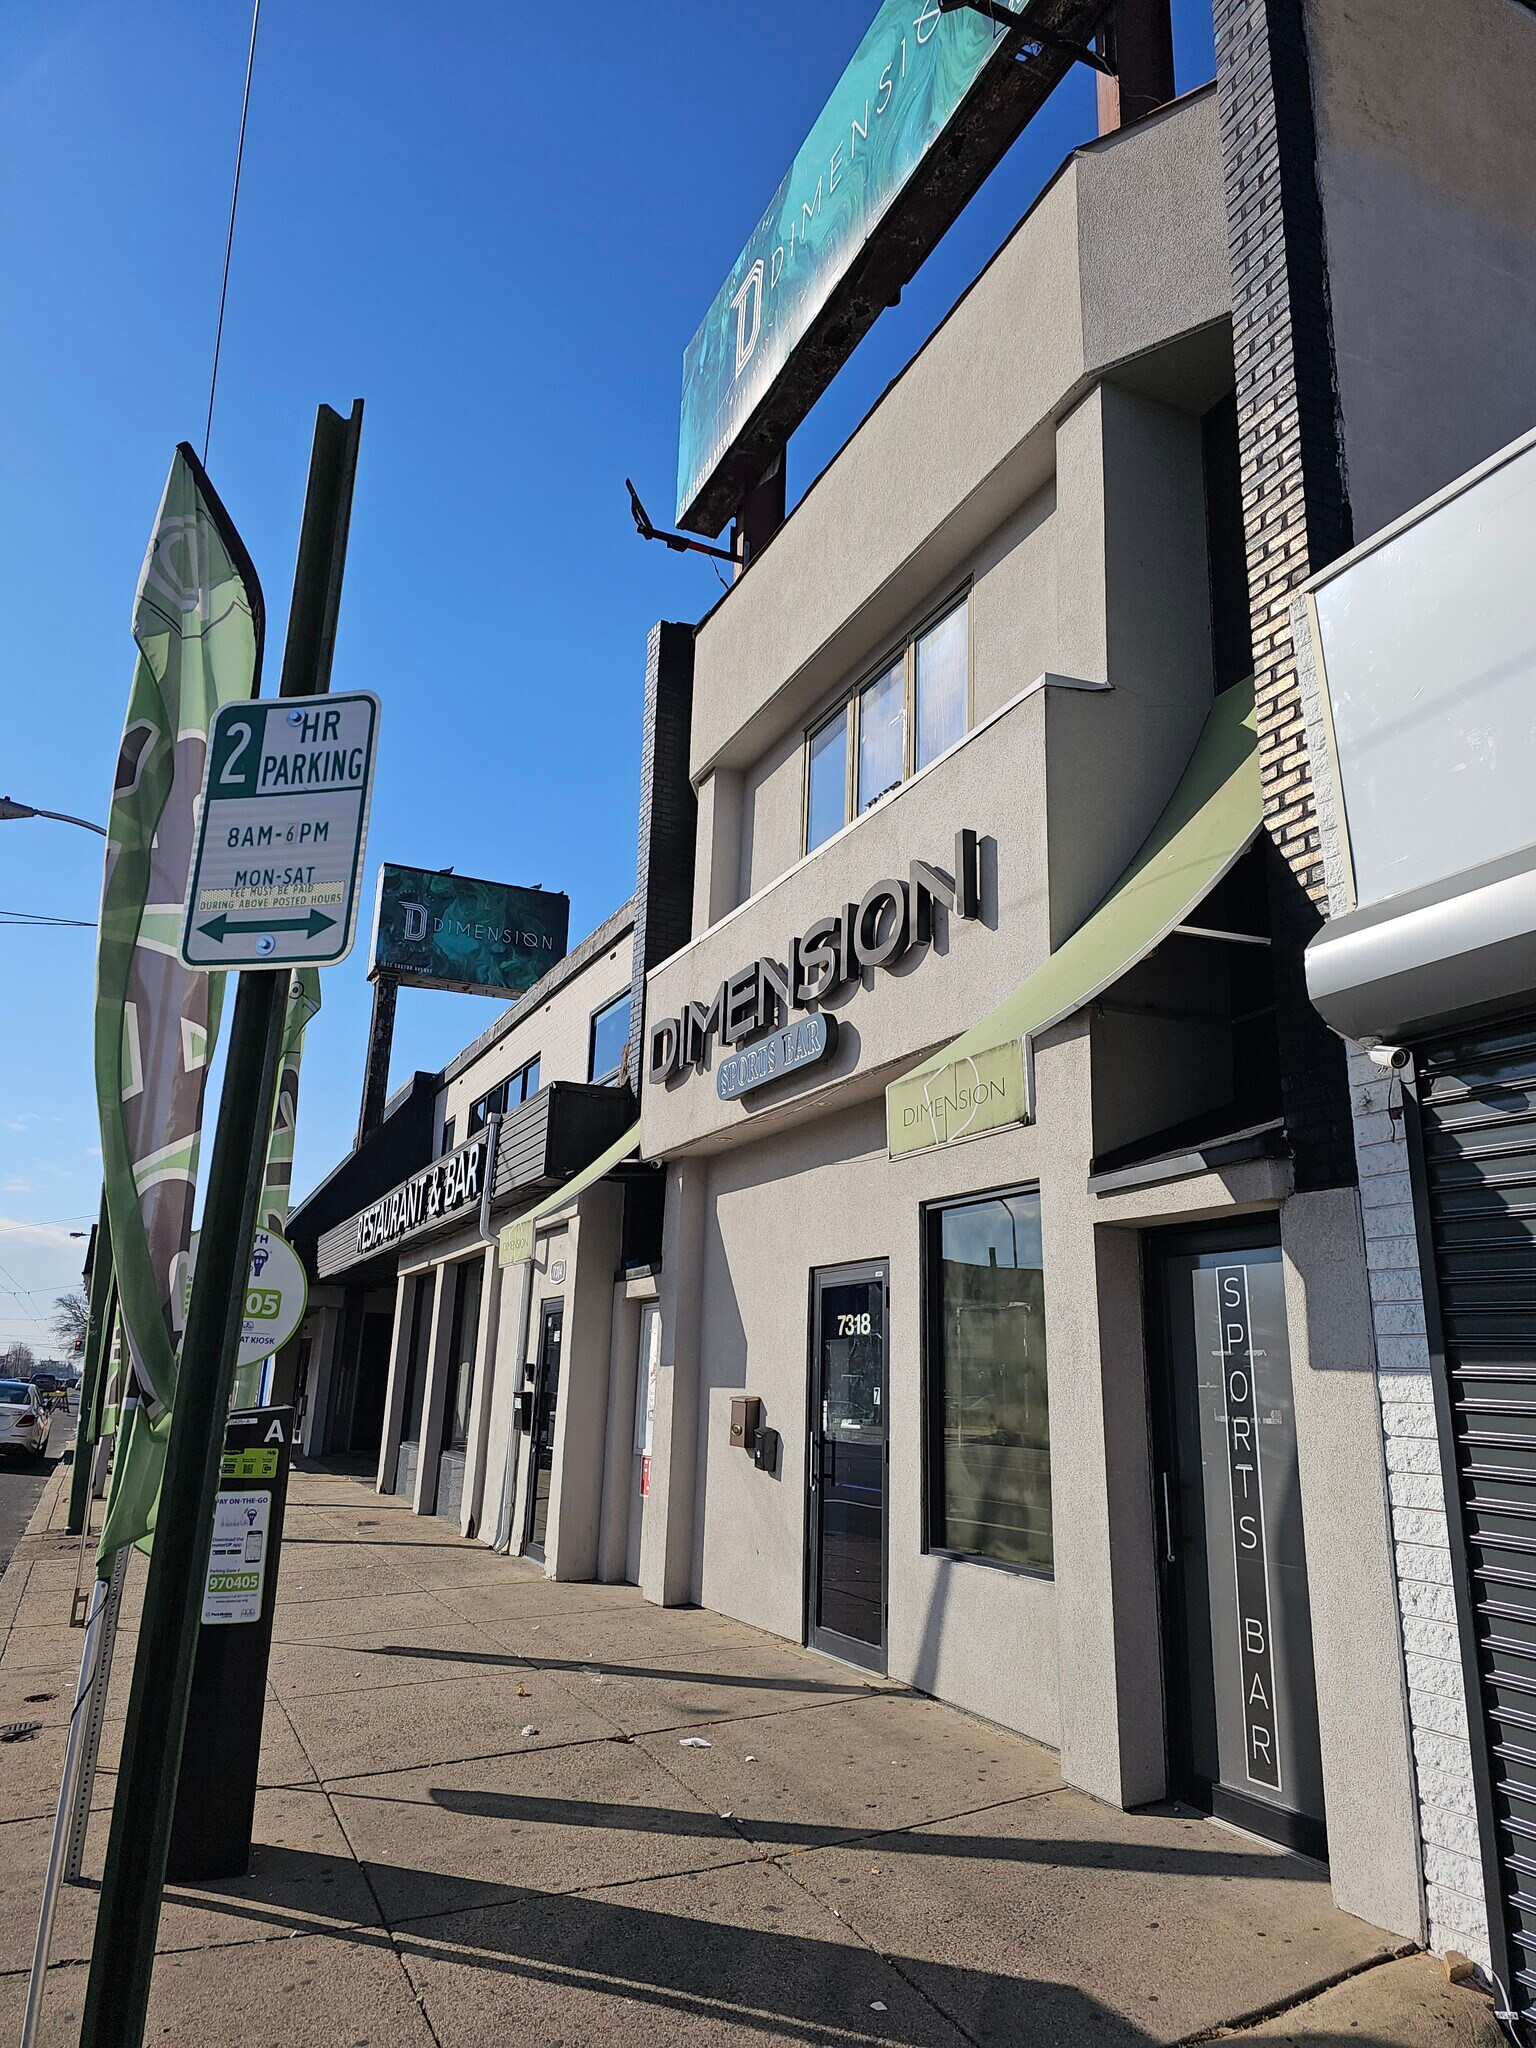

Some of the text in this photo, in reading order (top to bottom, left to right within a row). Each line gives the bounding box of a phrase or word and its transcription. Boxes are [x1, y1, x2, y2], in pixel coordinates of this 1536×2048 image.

[301, 711, 341, 743] HR
[219, 722, 251, 784] 2
[262, 748, 363, 786] PARKING
[227, 821, 330, 847] 8AM-6PM
[230, 883, 314, 898] FEE MUST BE PAID
[234, 866, 315, 887] MON-SAT
[200, 893, 341, 911] DURING ABOVE POSTED HOURS
[398, 900, 553, 950] D DIMENSION
[649, 828, 978, 1085] DIMENSION
[720, 1020, 822, 1095] SPORTS BAR
[903, 1062, 1006, 1141] DIMENSION
[356, 1143, 479, 1251] RESTAURANT & BAR
[837, 1312, 871, 1336] 7318
[240, 1336, 275, 1345] AT KIOSK
[264, 1419, 284, 1442] A
[1222, 1277, 1272, 1766] SPORTS BAR
[210, 1576, 258, 1590] 970405
